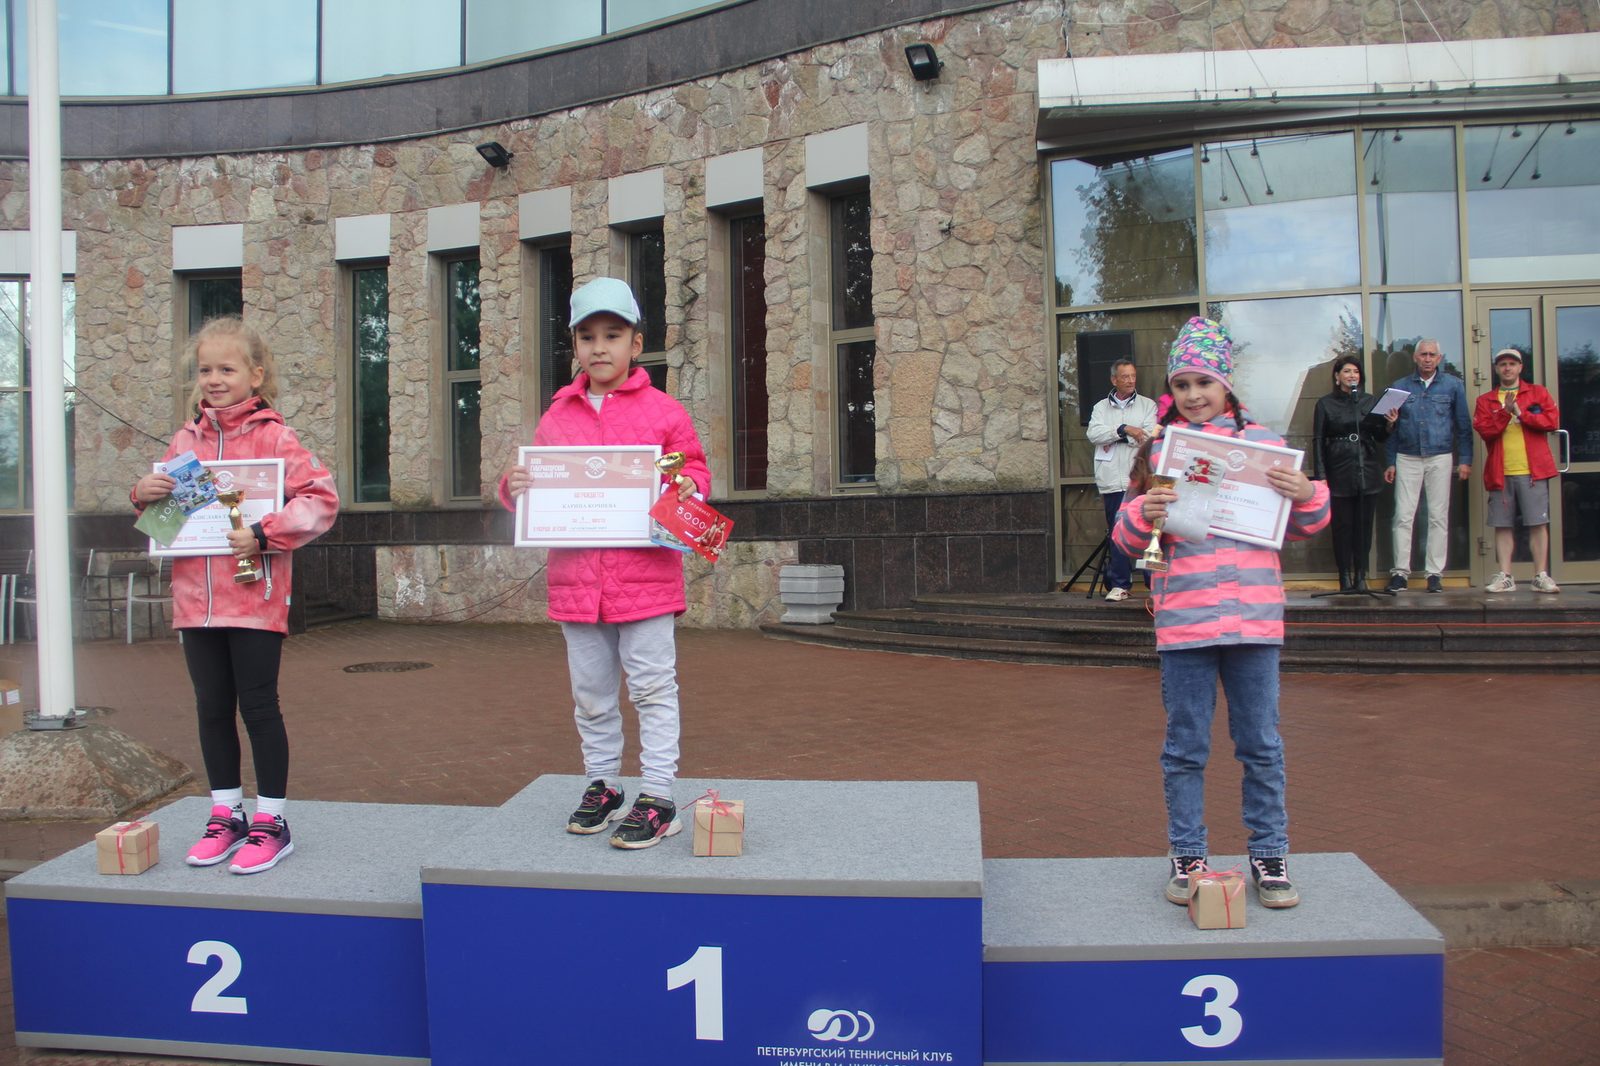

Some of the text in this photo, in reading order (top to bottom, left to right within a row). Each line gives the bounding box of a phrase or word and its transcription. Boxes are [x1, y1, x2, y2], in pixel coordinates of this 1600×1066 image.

[187, 940, 248, 1014] 2
[667, 946, 723, 1041] 1
[1181, 974, 1243, 1048] 3
[757, 1046, 953, 1062] ПЕТЕРБУРГСКИЙ ТЕННИСНЫЙ КЛУБ
